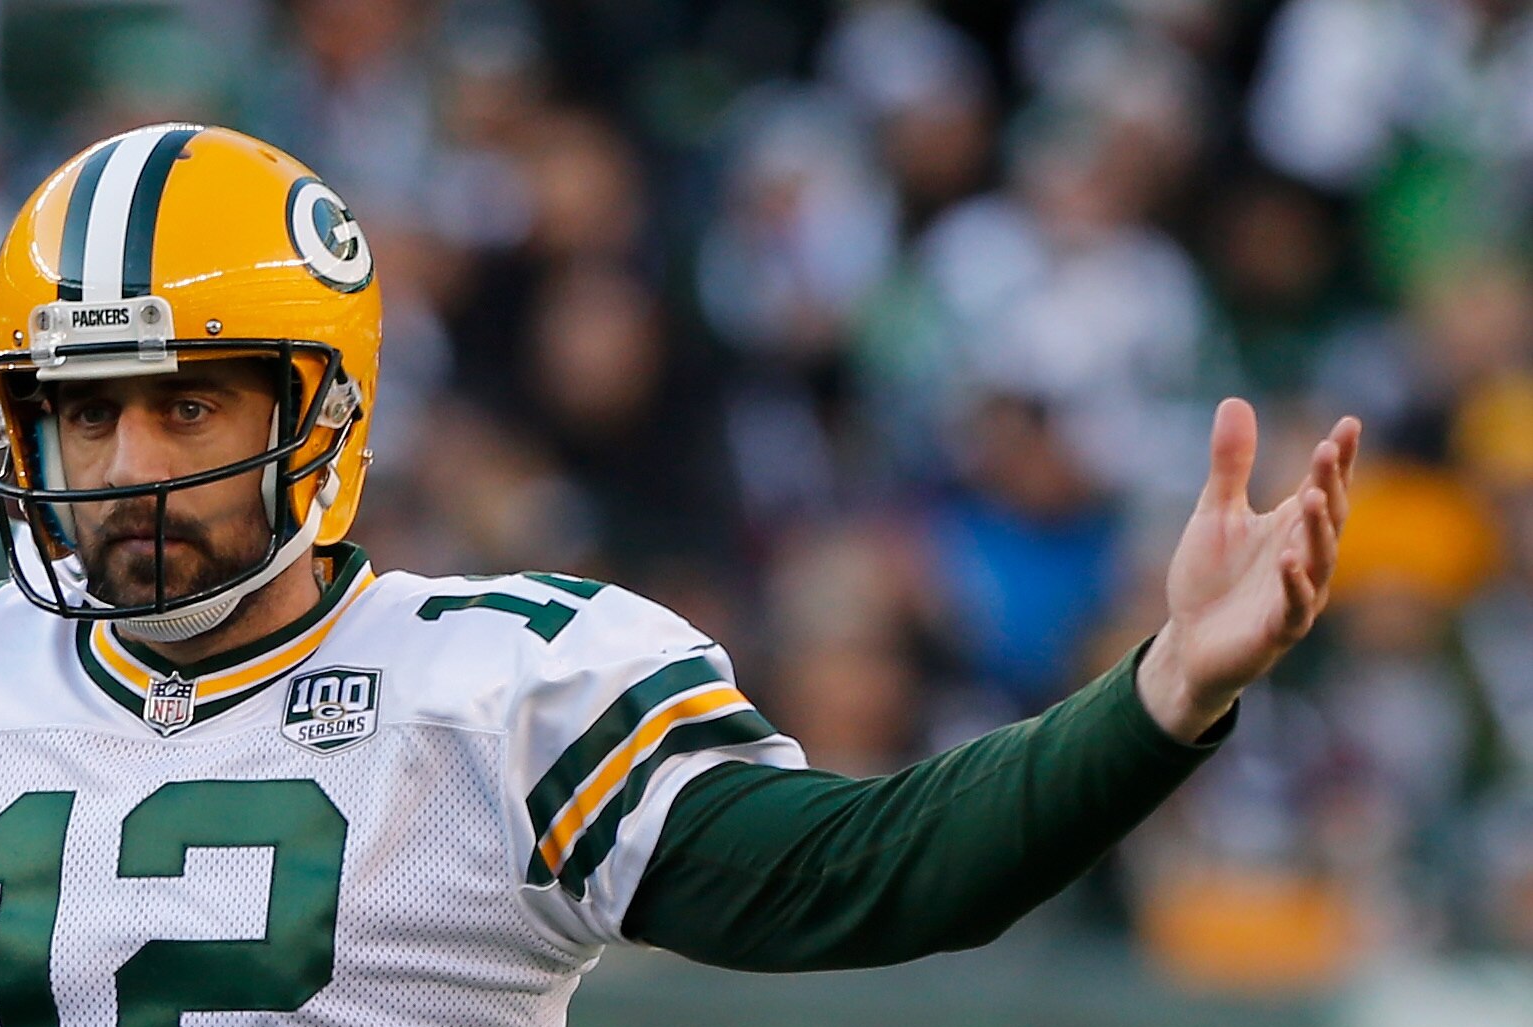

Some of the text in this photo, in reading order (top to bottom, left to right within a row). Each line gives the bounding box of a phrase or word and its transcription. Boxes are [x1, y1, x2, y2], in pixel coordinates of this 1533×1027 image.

[72, 308, 130, 328] PACKERS
[292, 676, 371, 714] 100
[152, 699, 185, 722] NFL
[298, 716, 365, 742] SEASONS
